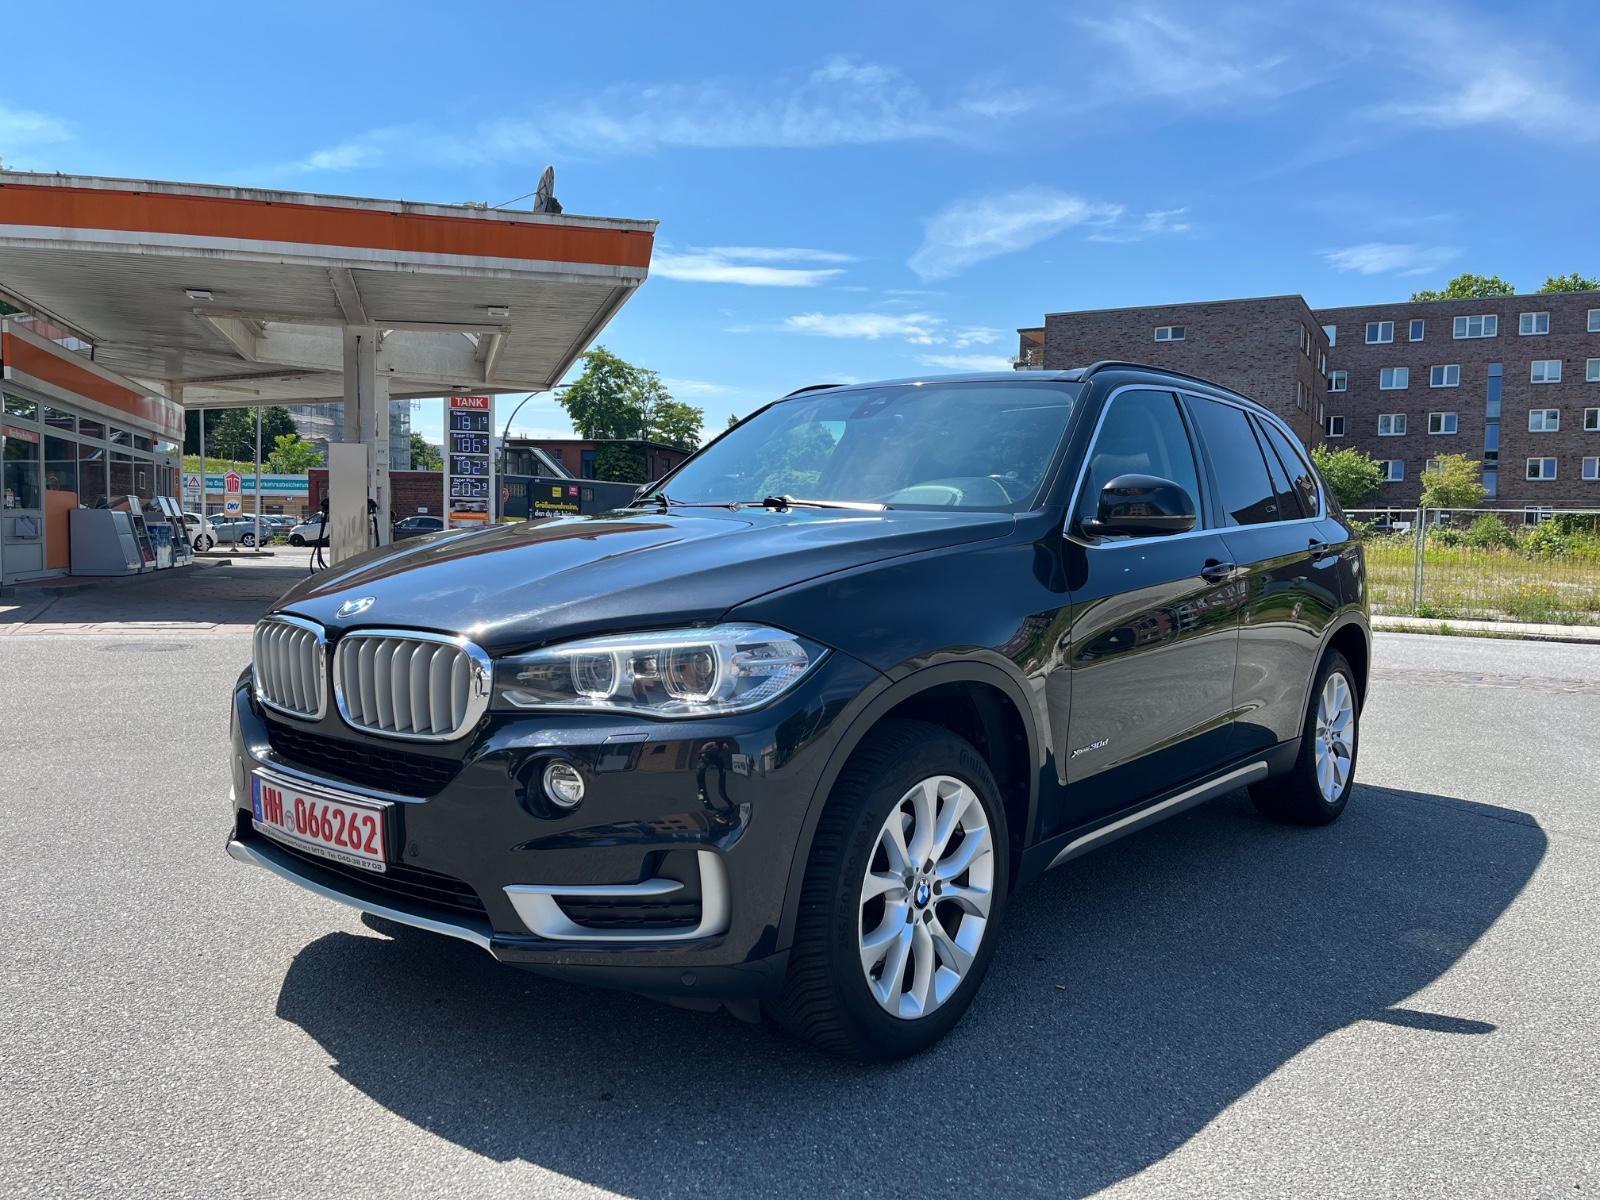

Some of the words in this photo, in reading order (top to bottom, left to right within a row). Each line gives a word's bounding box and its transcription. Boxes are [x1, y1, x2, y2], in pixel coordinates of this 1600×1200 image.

[455, 397, 484, 408] TANK
[226, 502, 240, 511] DKV
[262, 784, 285, 828] HH
[294, 797, 379, 856] 066262
